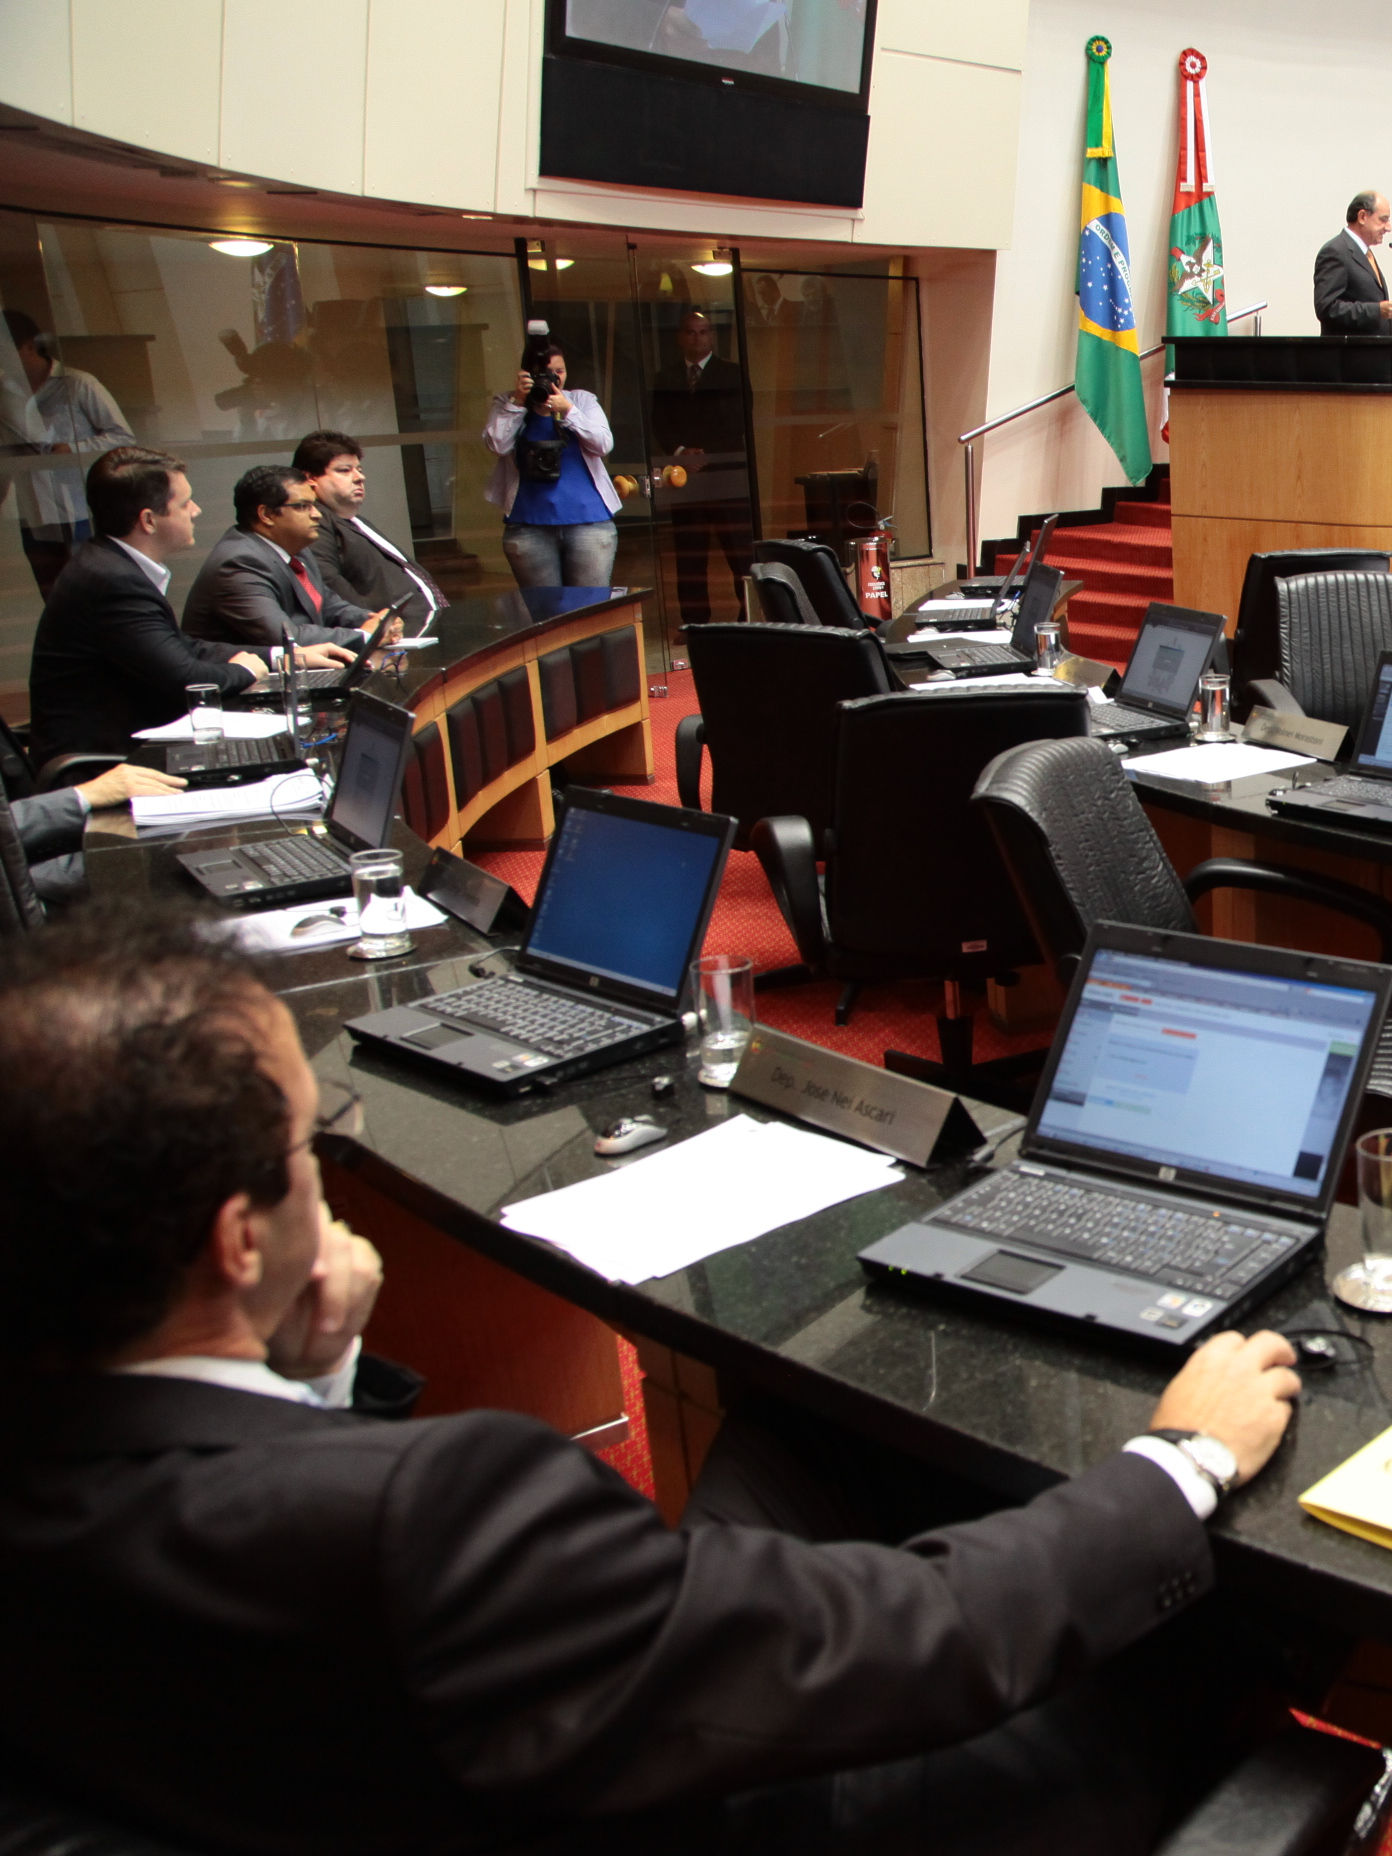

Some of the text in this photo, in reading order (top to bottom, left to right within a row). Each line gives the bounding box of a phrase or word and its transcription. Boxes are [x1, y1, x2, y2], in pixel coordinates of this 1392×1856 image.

[1095, 224, 1116, 252] ORDEM
[1113, 250, 1121, 259] E
[865, 591, 888, 599] PAPEL
[854, 1100, 897, 1126] Ascari
